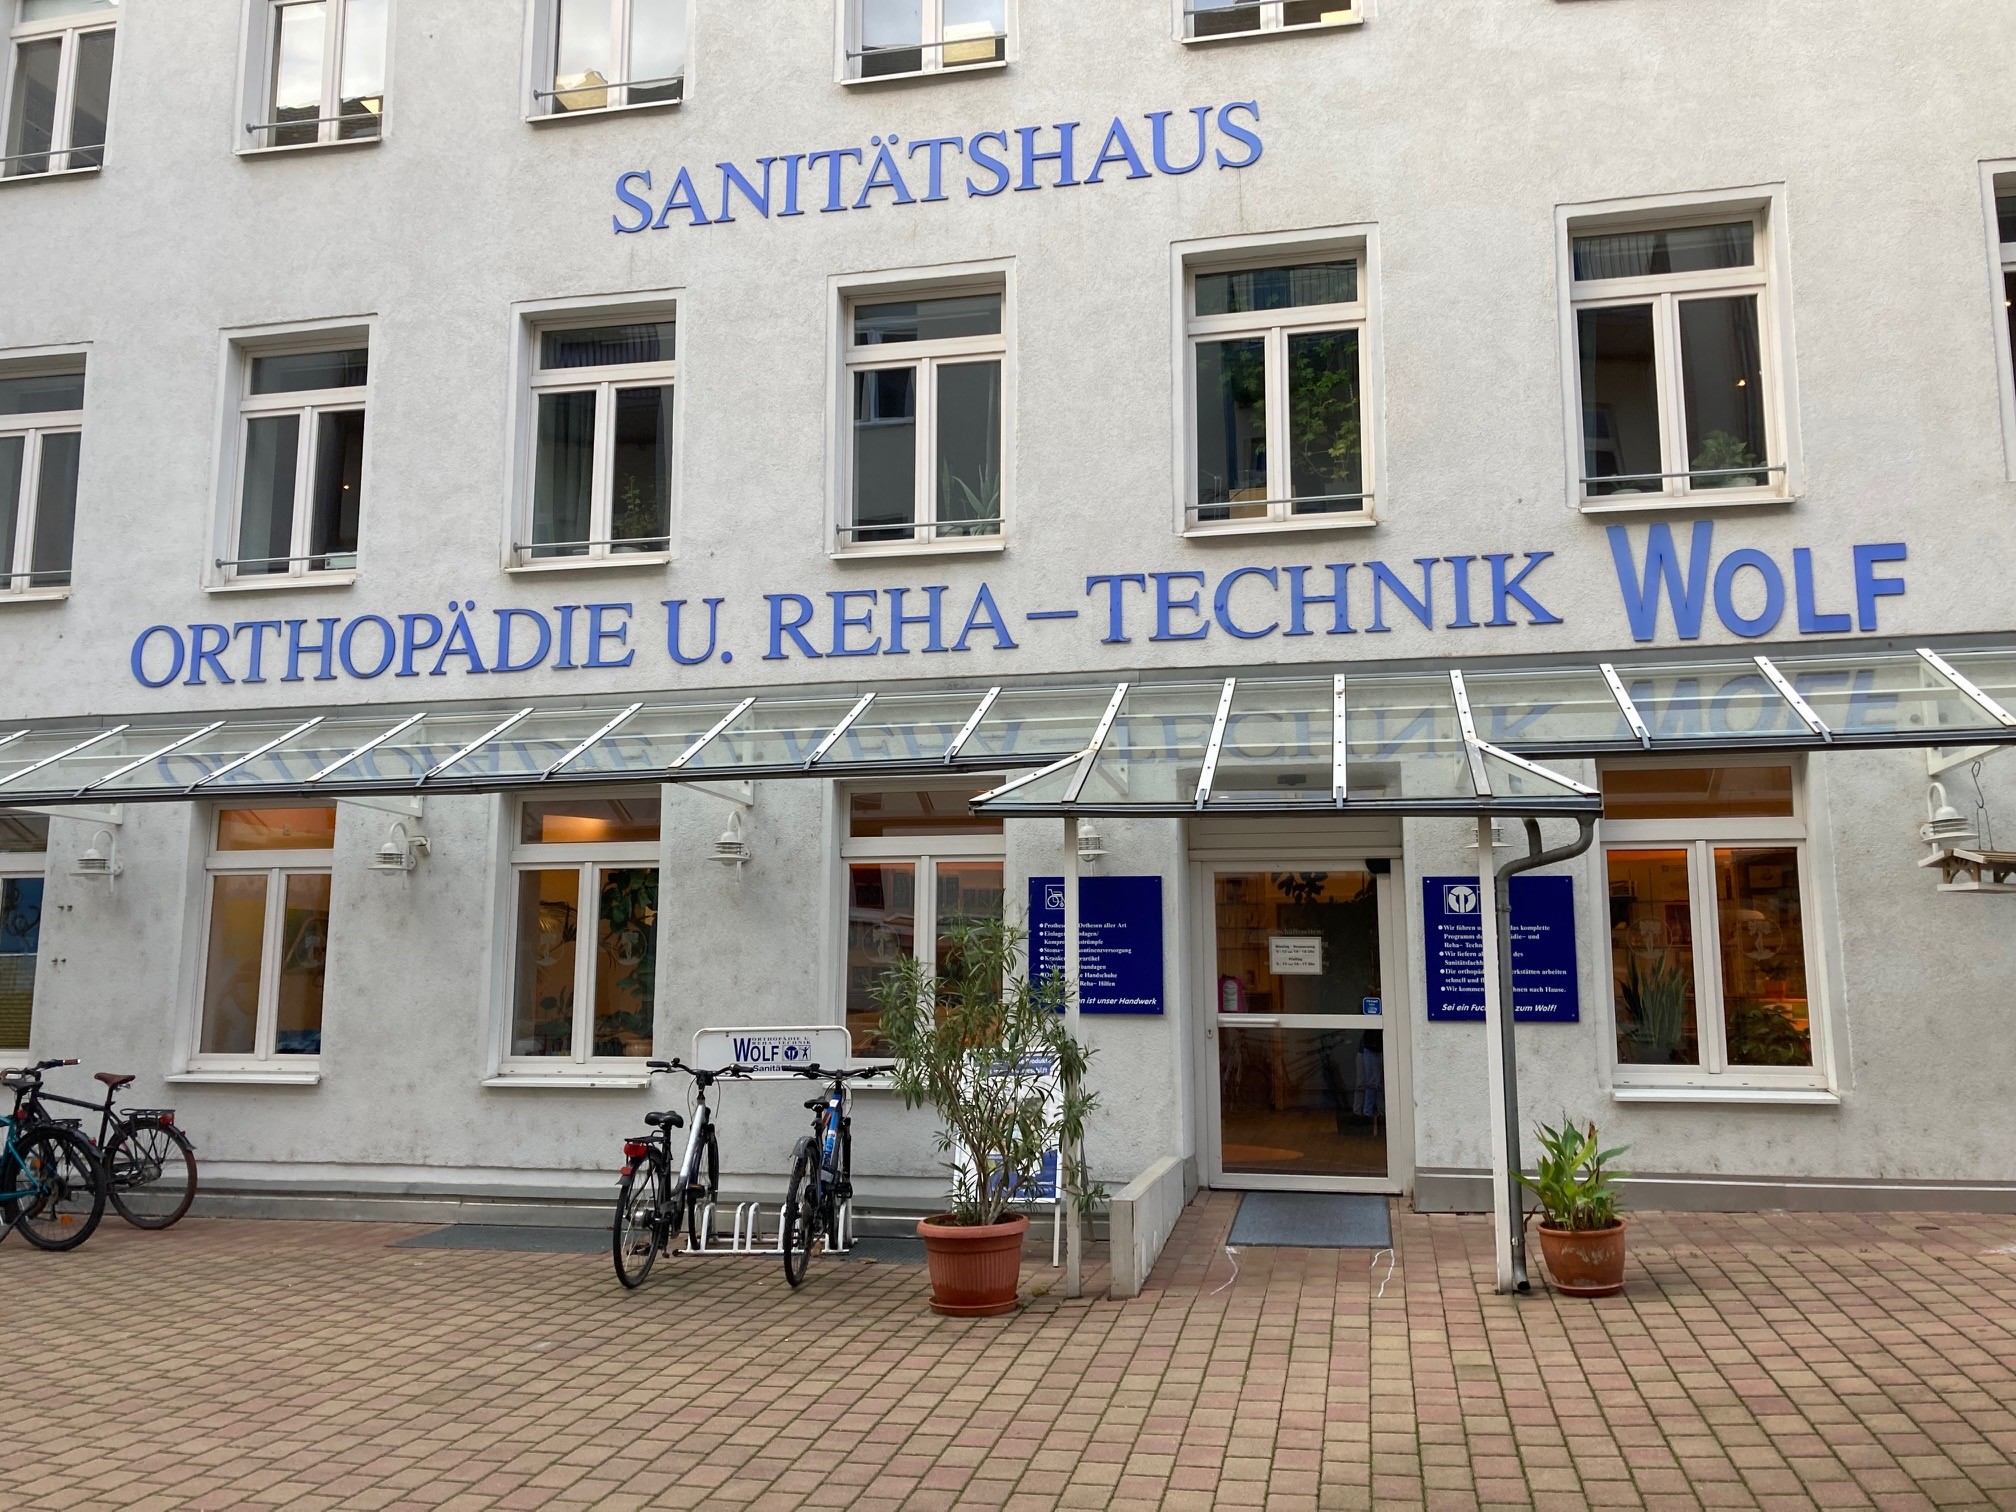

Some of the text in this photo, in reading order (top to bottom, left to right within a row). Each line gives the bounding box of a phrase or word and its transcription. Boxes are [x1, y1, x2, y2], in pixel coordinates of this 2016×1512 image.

[612, 100, 1263, 235] SANITÄTSHAUS
[131, 600, 634, 689] ORTHOPÄDIE
[663, 598, 733, 666] U.
[1606, 520, 1907, 641] WOLF
[1442, 1003, 1456, 1011] Sei
[1534, 1004, 1557, 1012] Wolf!
[733, 1038, 780, 1062] WOLF
